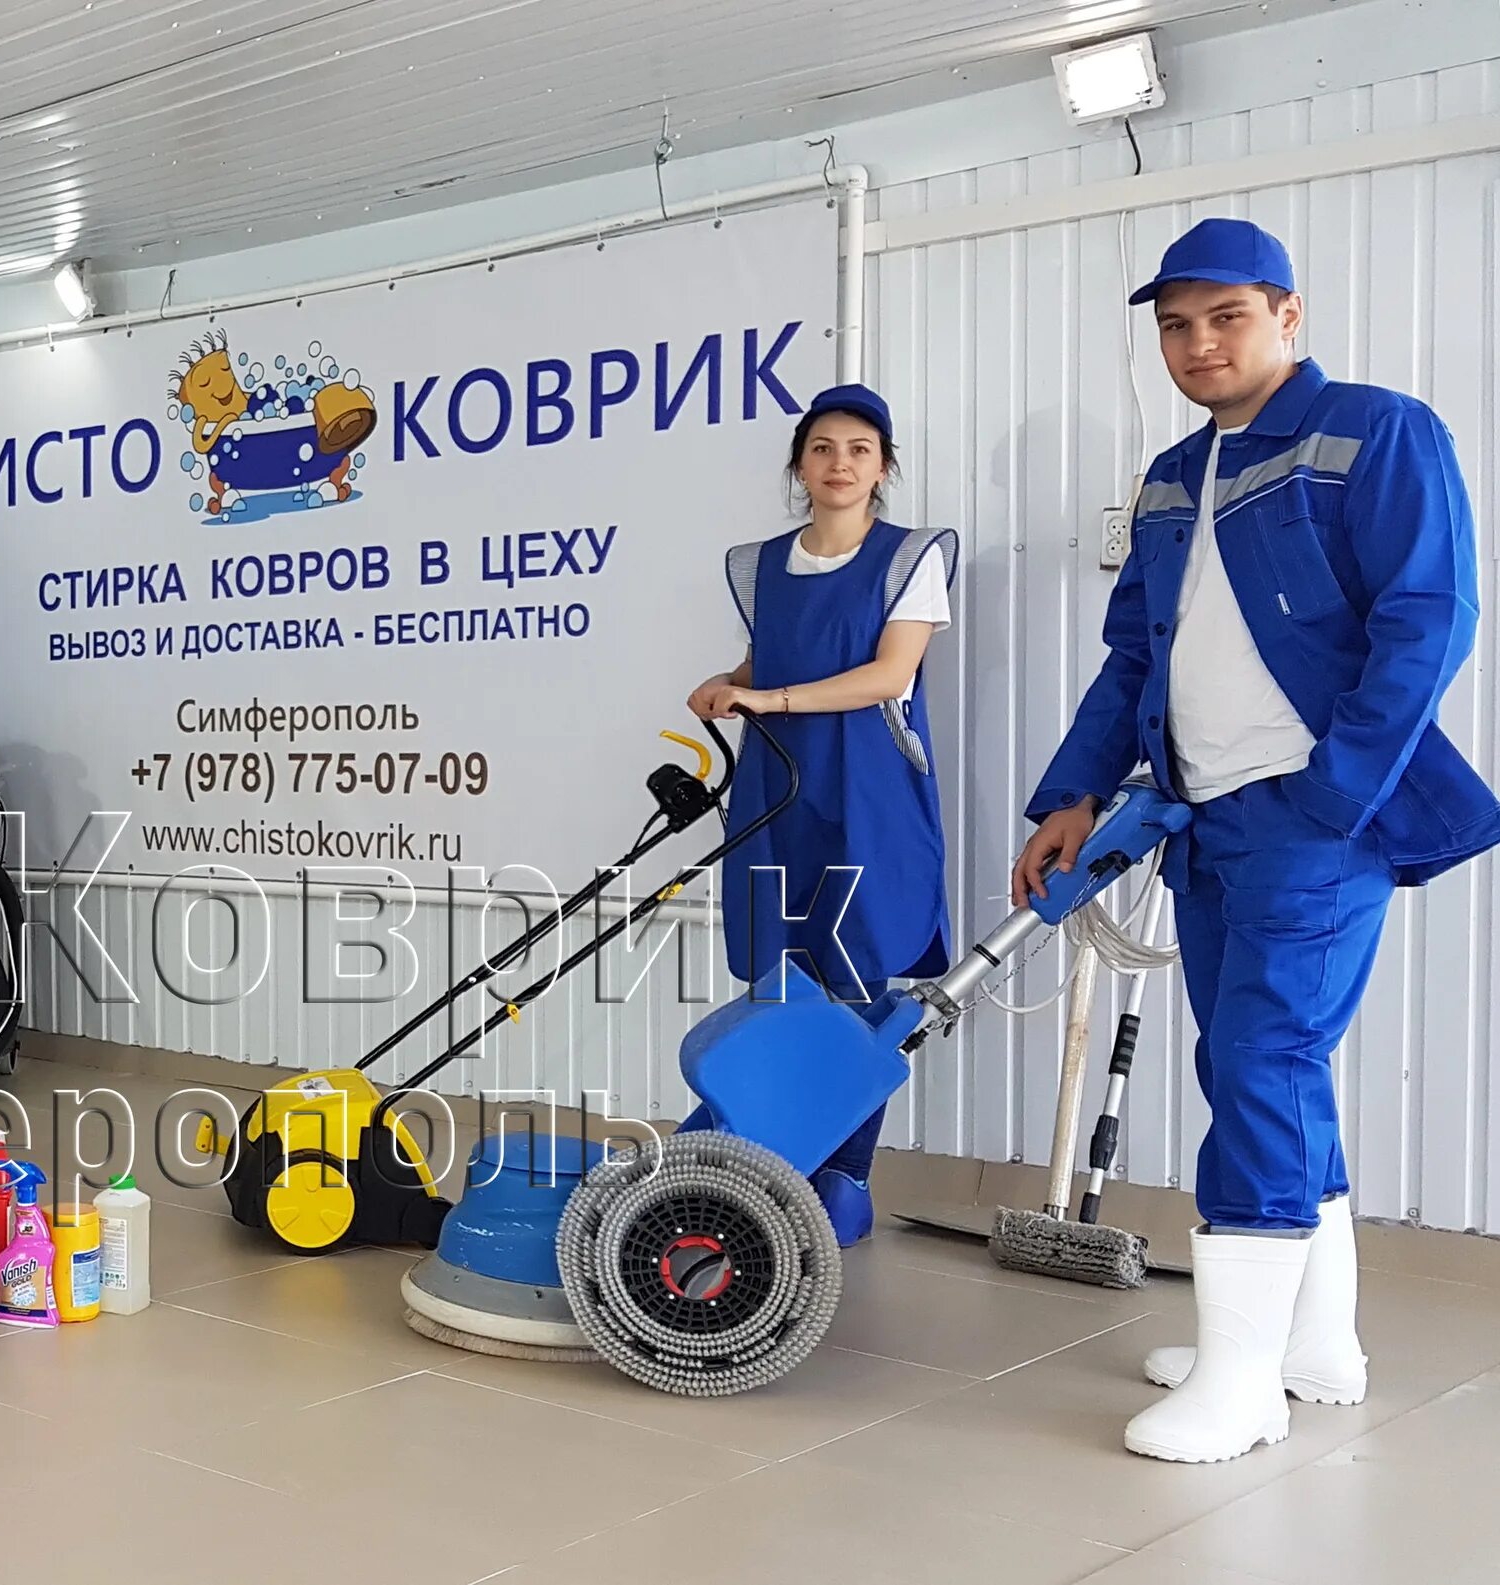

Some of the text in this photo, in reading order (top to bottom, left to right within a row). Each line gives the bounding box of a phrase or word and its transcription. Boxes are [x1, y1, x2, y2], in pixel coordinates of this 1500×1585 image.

[393, 320, 805, 463] КОВРИК
[38, 525, 618, 613] СТИРКА КОВРОВ В ЦЕХУ
[49, 628, 147, 661] ВЫВОЗ
[156, 626, 174, 656] И
[181, 617, 345, 661] ДОСТАВКА
[374, 603, 590, 647] БЕСПЛАТНО
[176, 698, 419, 743] Симферополь
[130, 751, 489, 804] +7 (978) 775-07-09
[142, 820, 462, 863] www.chistokovrik.ru
[1, 1258, 38, 1286] Vanish
[11, 1275, 32, 1288] GOLD
